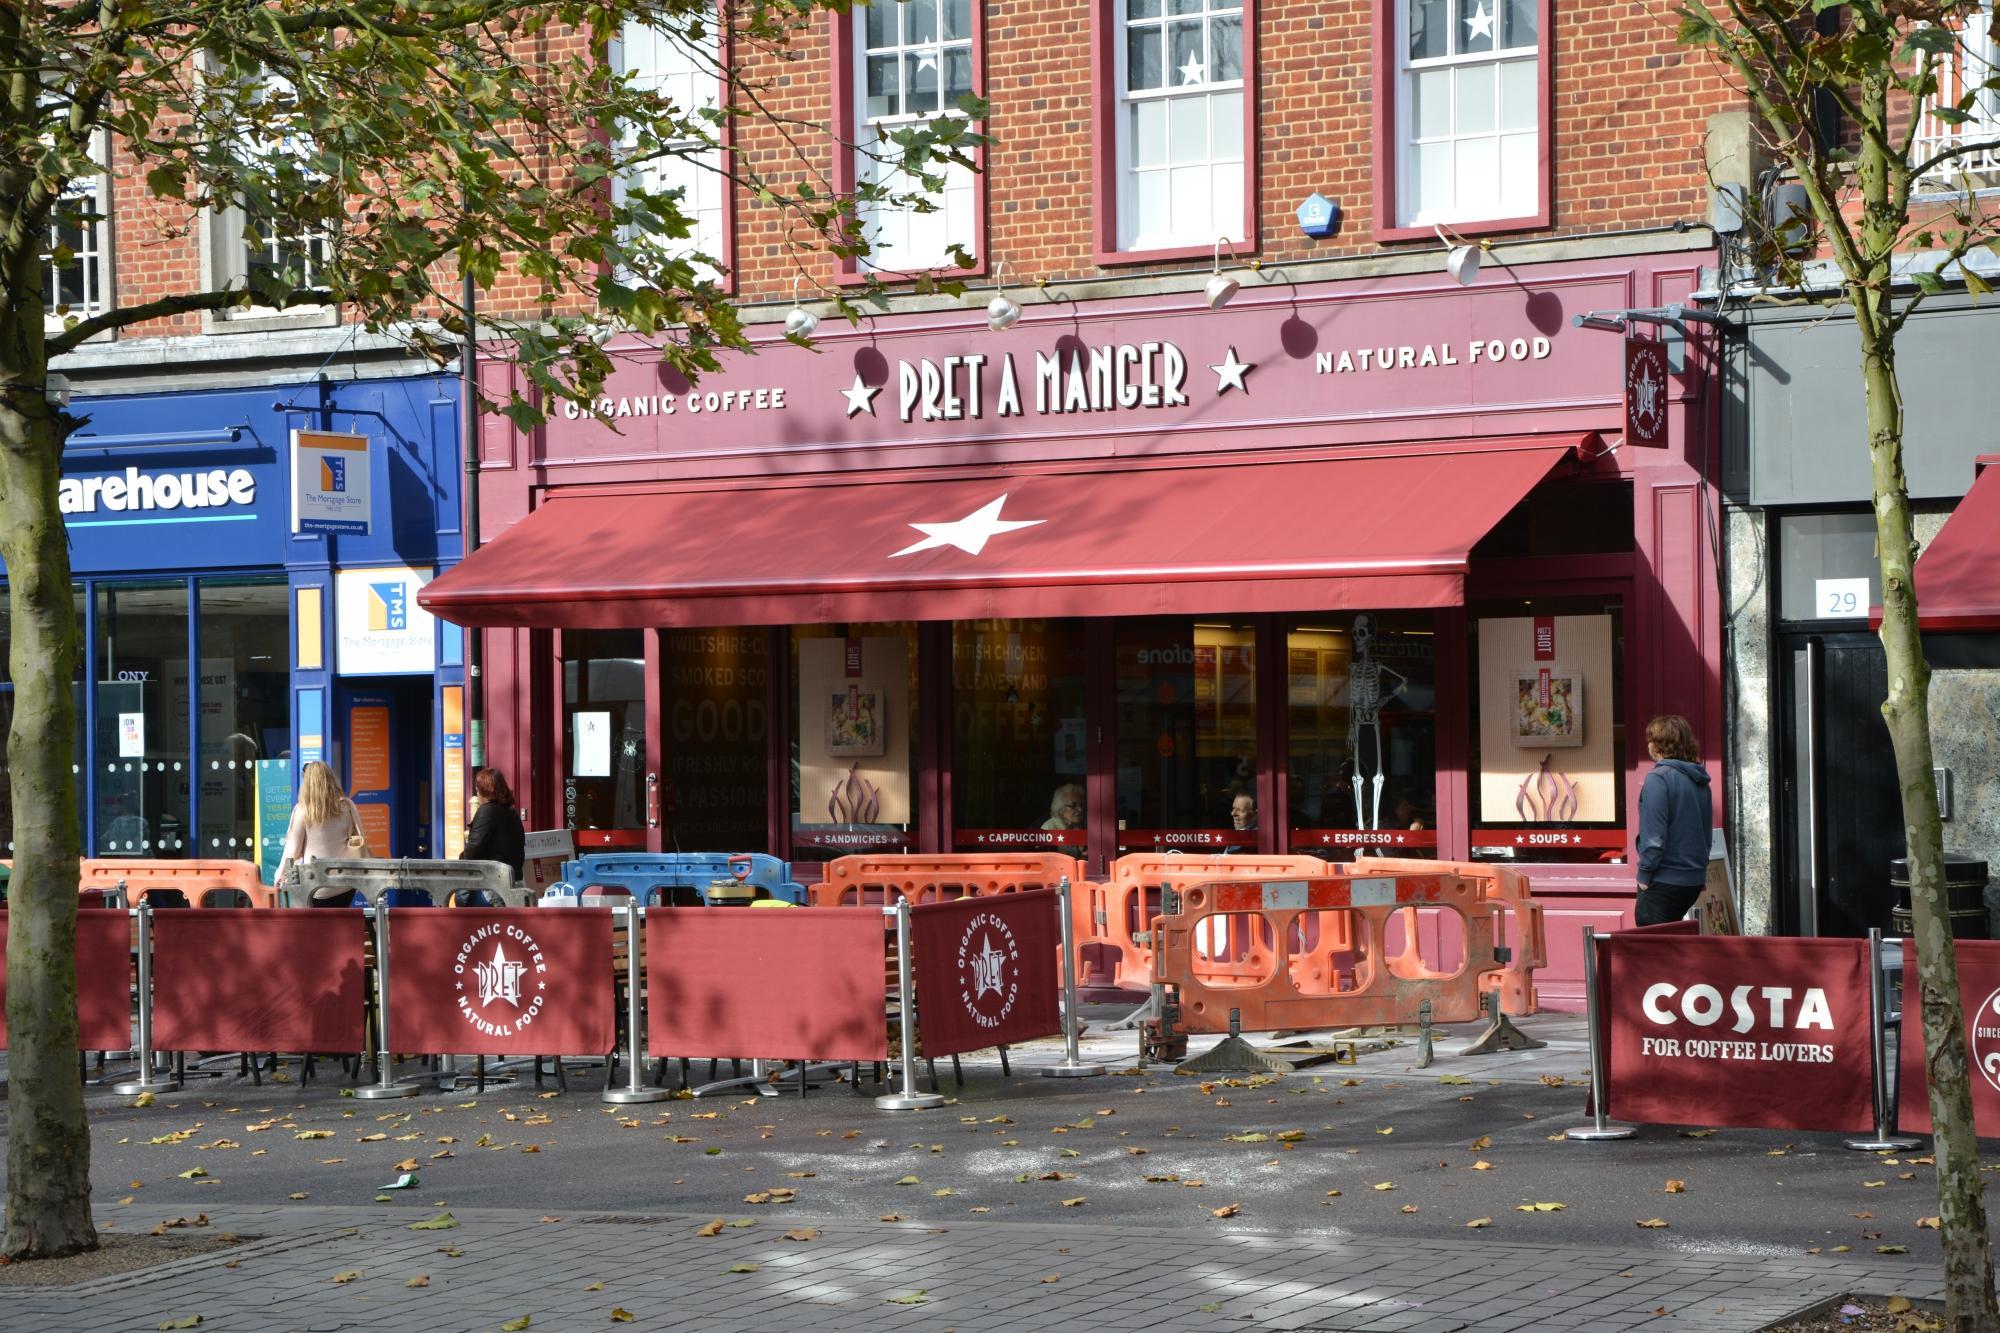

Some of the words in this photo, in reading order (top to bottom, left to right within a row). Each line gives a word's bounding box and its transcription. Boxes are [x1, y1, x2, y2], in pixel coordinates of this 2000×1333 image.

[1316, 343, 1458, 374] NATURAL
[1469, 336, 1551, 364] FOOD
[899, 353, 984, 421] PRET
[997, 351, 1020, 415] A
[1036, 341, 1186, 412] MANGER
[687, 388, 785, 413] COFFEE
[59, 466, 255, 514] arehouse
[335, 458, 344, 490] TMS
[390, 583, 404, 629] TMS
[1829, 592, 1857, 613] 29
[824, 834, 888, 844] SANDWICHES
[988, 833, 1053, 843] CAPPUCCINO
[1165, 833, 1211, 843] COOKIES
[1334, 833, 1392, 844] ESPRESSO
[1528, 833, 1568, 844] SOUPS
[454, 923, 501, 974] ORGANIC
[507, 925, 546, 974] COFFEE
[958, 913, 986, 969] ORGANIC
[989, 914, 1019, 960] COFFEE
[478, 961, 523, 998] PRET
[973, 950, 1004, 990] PRET
[458, 996, 512, 1036] NATURAL
[515, 996, 543, 1031] FOOD
[962, 990, 1000, 1028] NATURAL
[1000, 983, 1018, 1020] FOOD
[1642, 982, 1835, 1034] COSTA
[1642, 1037, 1681, 1057] FOR
[1685, 1039, 1756, 1060] COFFEE
[1760, 1042, 1835, 1064] LOVERS
